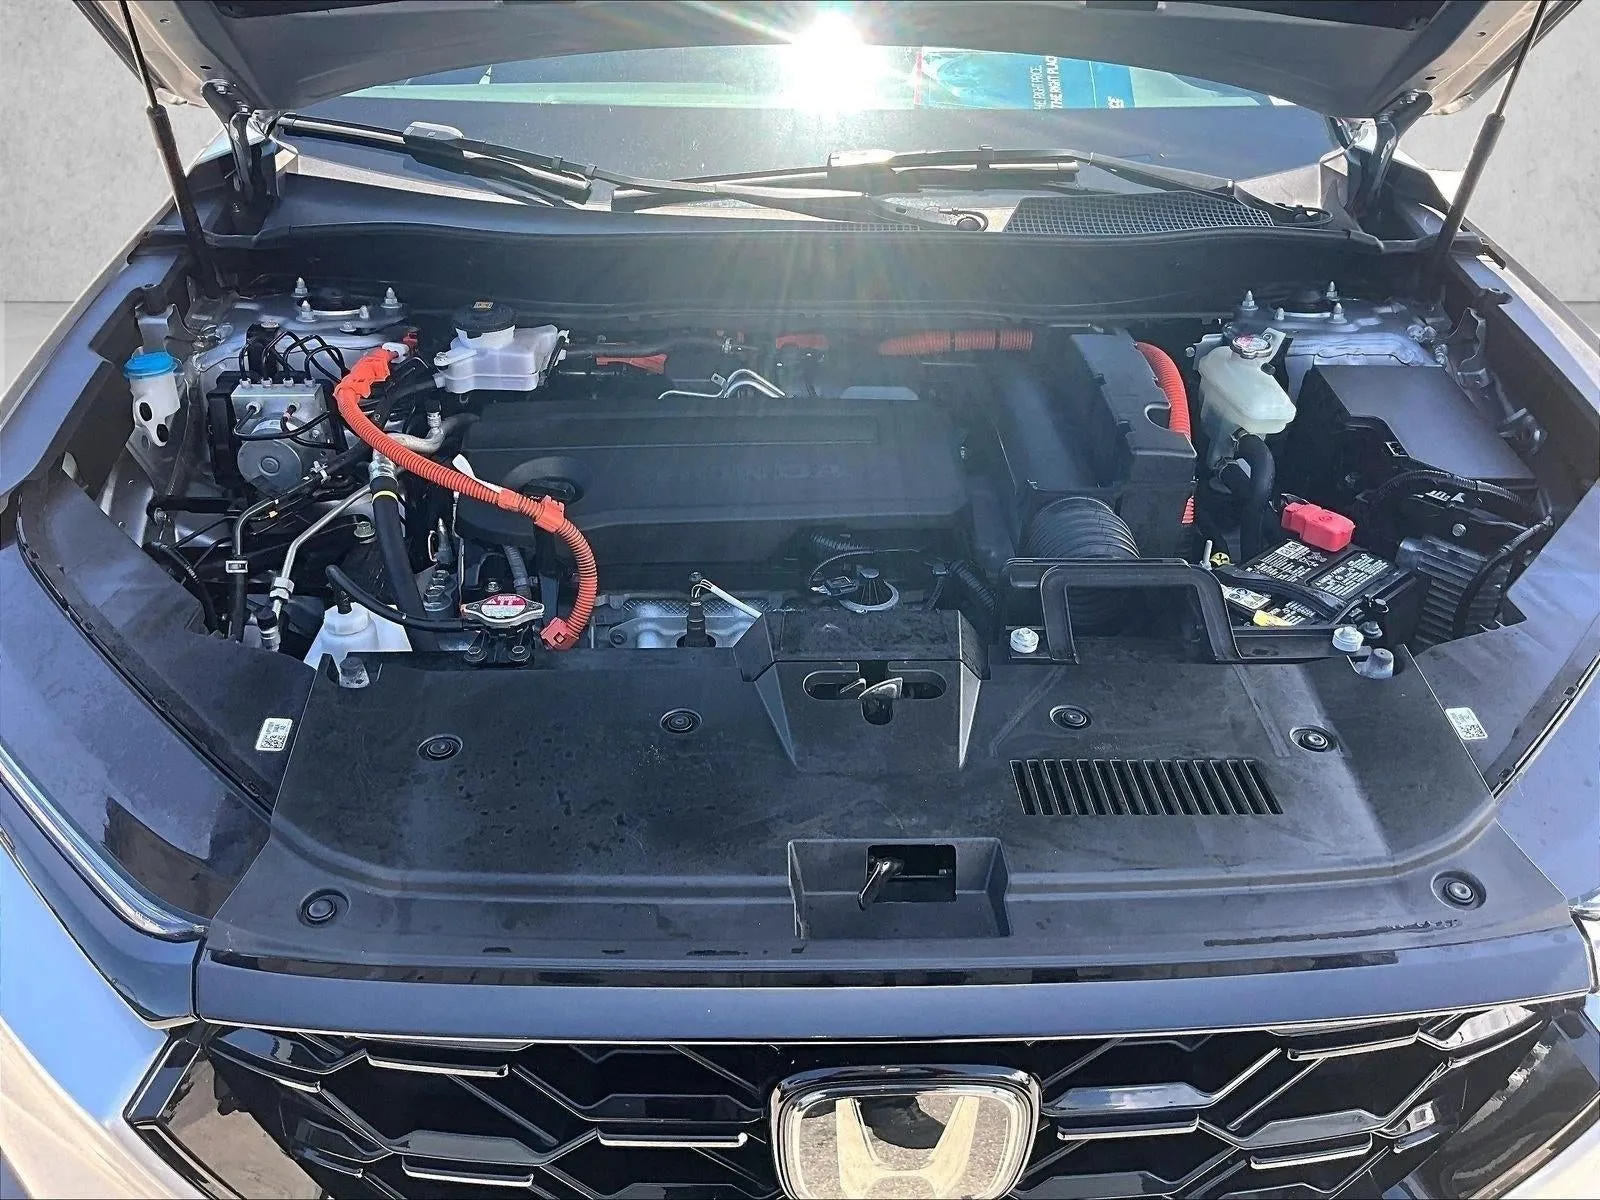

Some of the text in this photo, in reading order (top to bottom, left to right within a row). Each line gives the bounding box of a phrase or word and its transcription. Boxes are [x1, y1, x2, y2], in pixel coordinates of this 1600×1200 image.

[1045, 56, 1063, 109] THE RIGHT PLAC
